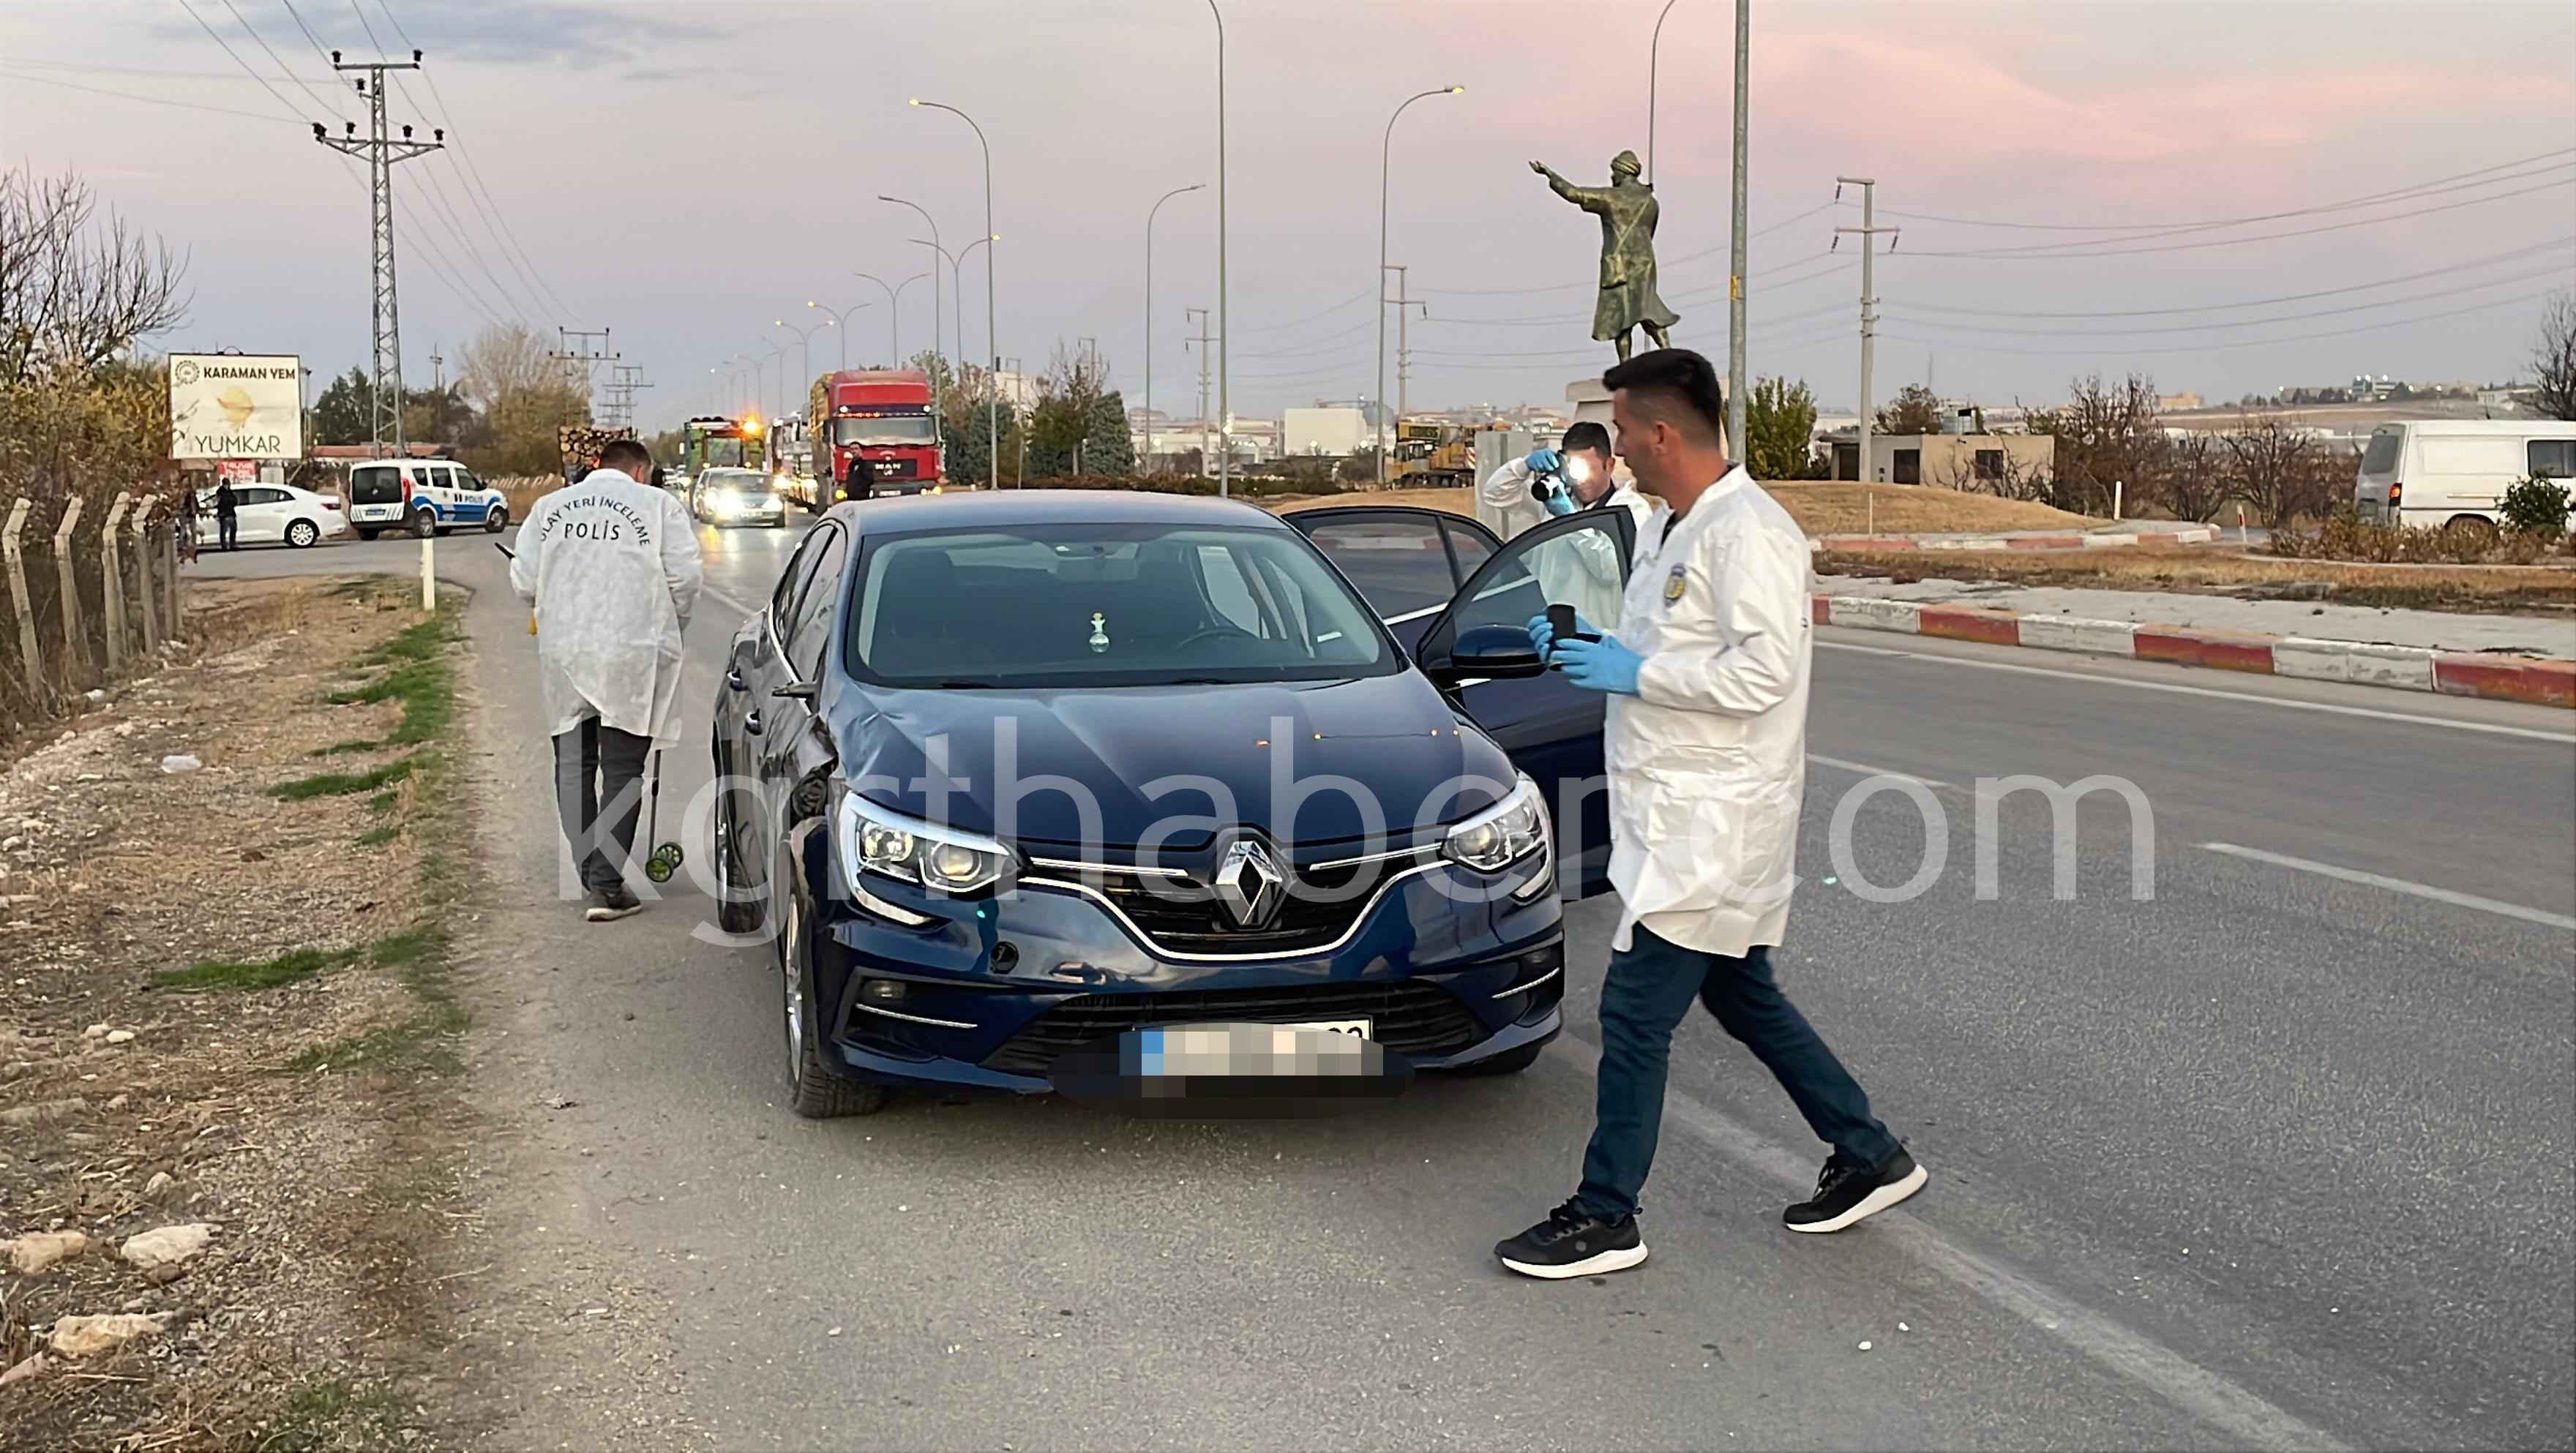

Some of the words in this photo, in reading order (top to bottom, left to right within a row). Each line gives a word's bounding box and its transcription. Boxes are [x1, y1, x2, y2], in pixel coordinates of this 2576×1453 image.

[203, 367, 267, 380] KARAMAN
[271, 368, 296, 380] YEM
[195, 435, 281, 454] YUMKAR
[564, 519, 621, 541] POLİS
